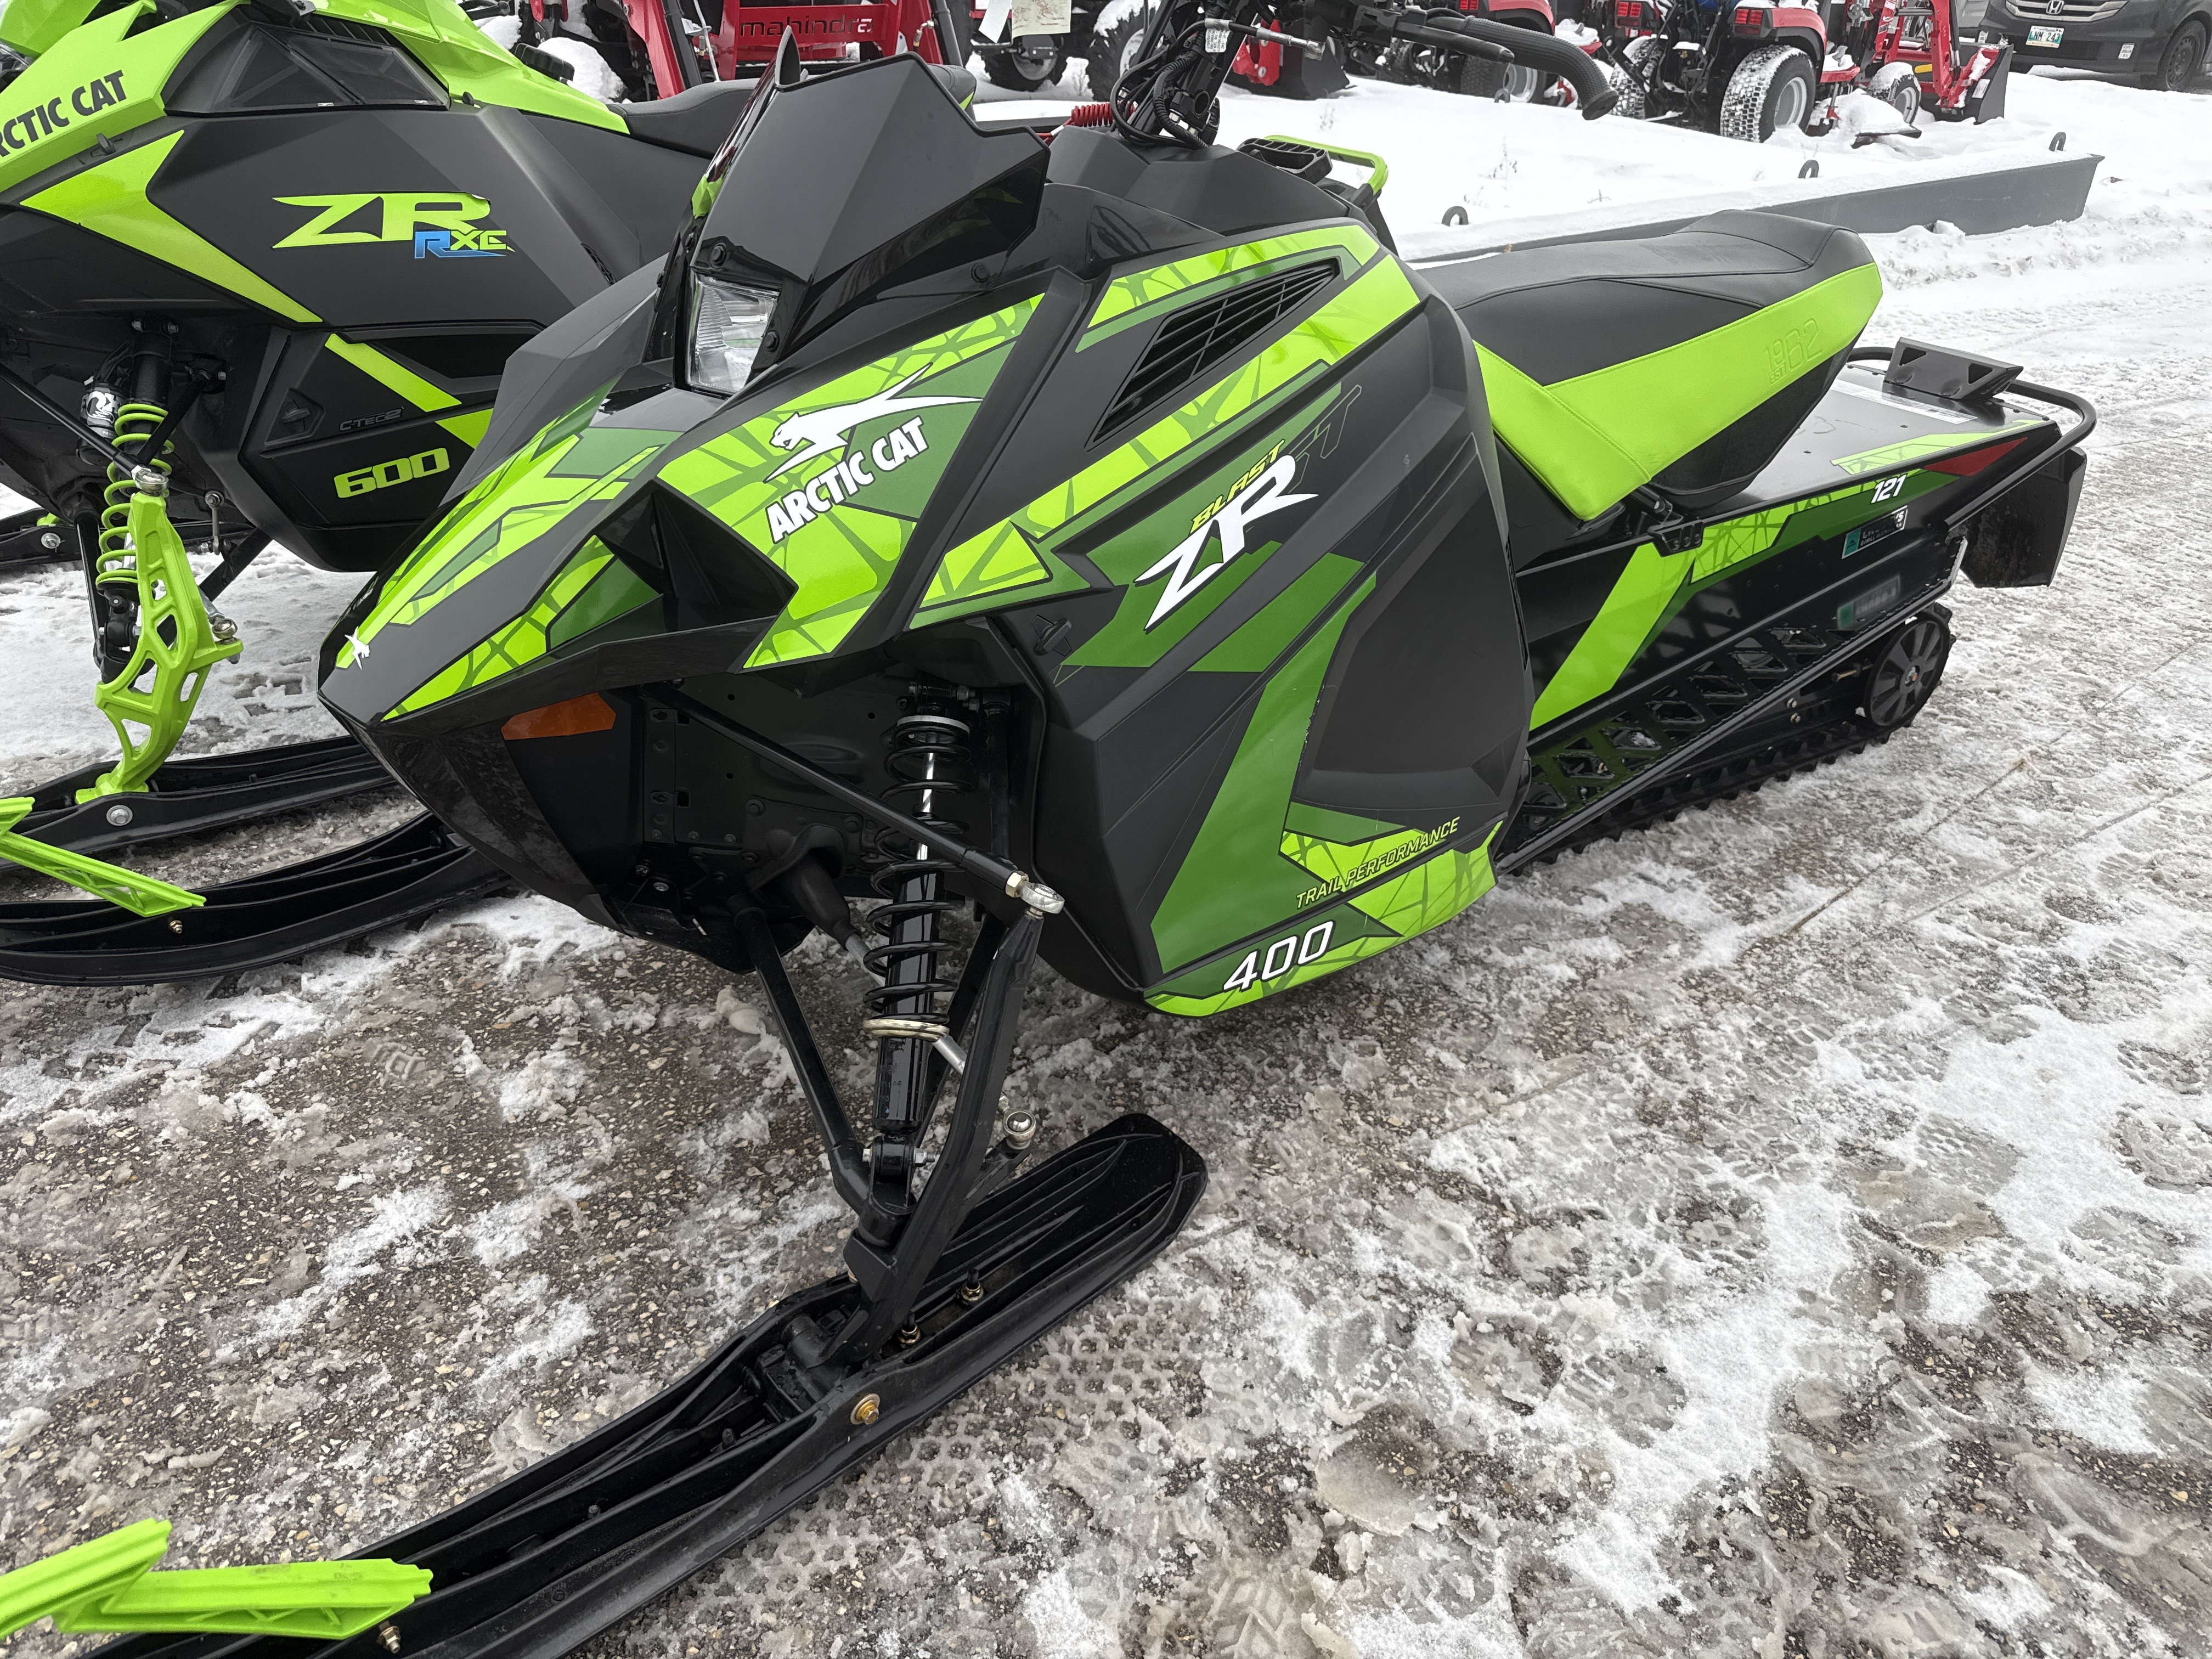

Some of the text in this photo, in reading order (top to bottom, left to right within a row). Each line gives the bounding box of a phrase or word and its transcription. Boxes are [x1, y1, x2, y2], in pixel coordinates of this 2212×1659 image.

[740, 14, 873, 37] mahindra
[2046, 32, 2061, 42] 243
[71, 69, 127, 116] CAT
[272, 192, 492, 249] ZR
[1763, 318, 1822, 372] 1962
[334, 448, 450, 499] 600
[766, 415, 929, 544] ARCTIC CAT
[1188, 439, 1285, 537] BLAST
[1871, 474, 1907, 504] 121
[1133, 455, 1319, 632] ZR
[1296, 816, 1461, 909] TRAIL PERFORMANCE
[1223, 920, 1336, 991] 400
